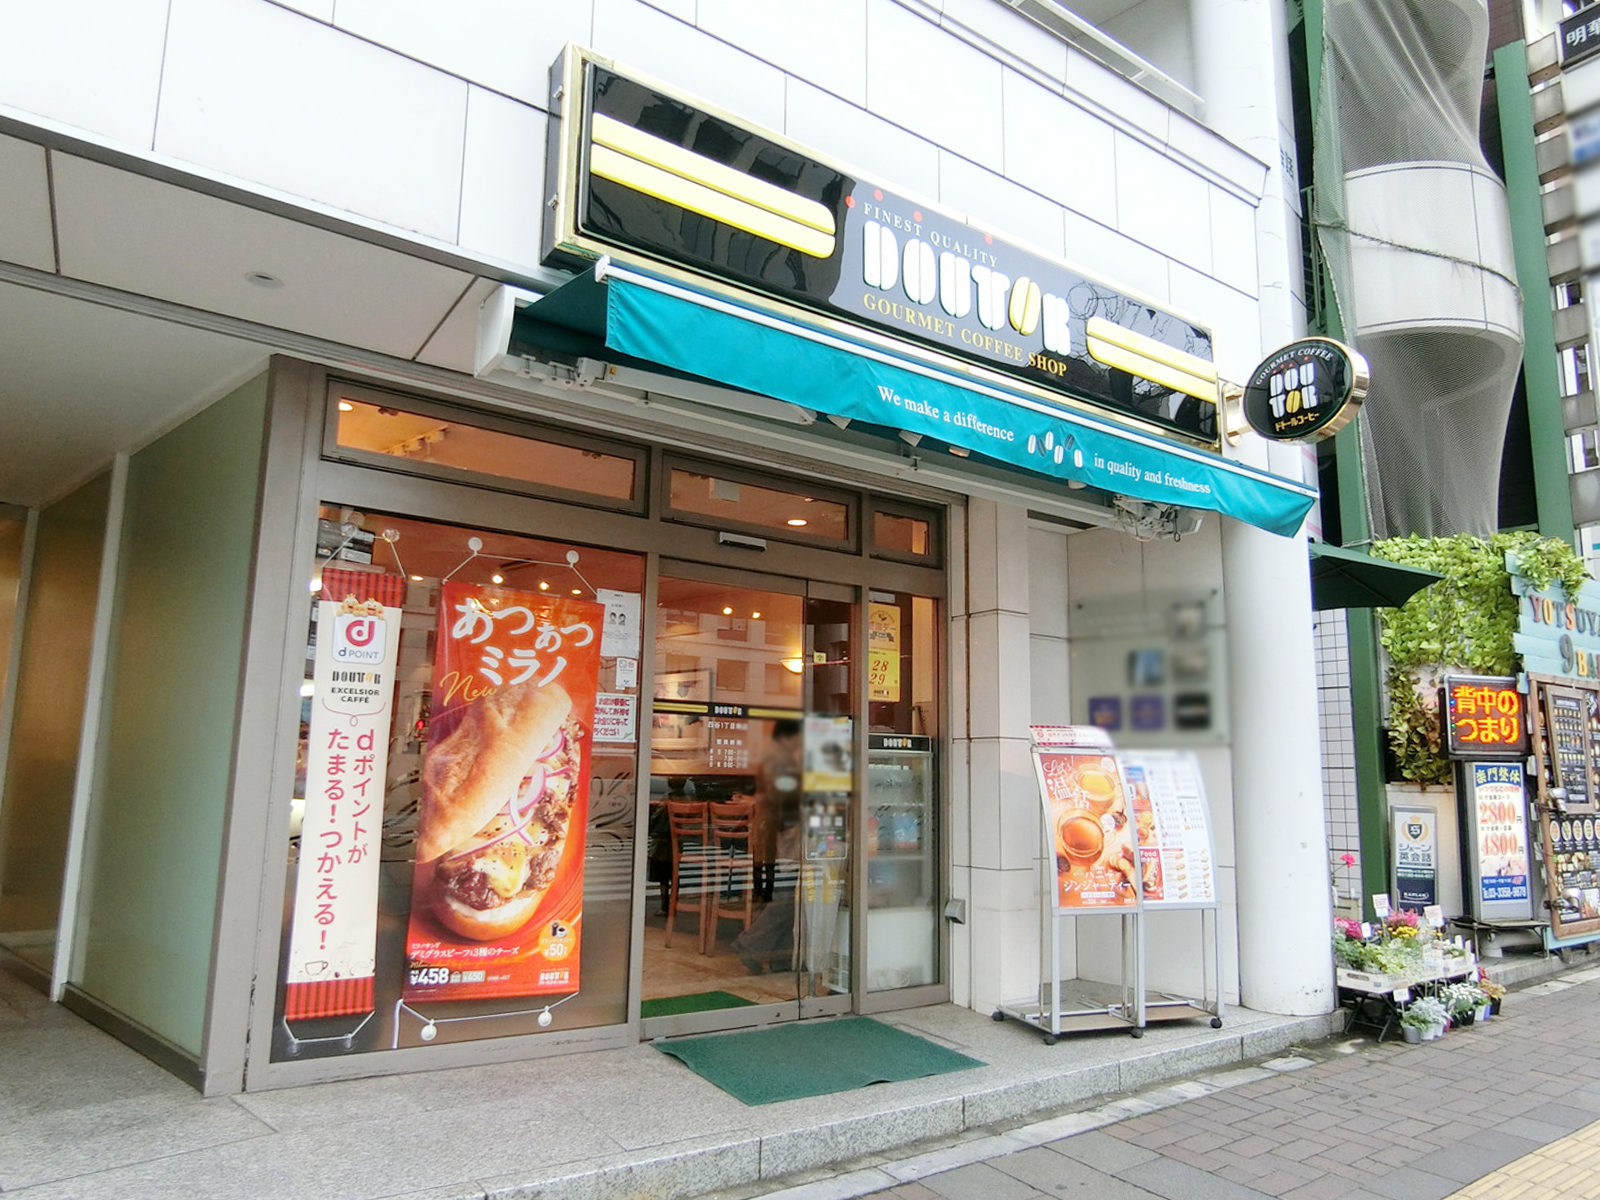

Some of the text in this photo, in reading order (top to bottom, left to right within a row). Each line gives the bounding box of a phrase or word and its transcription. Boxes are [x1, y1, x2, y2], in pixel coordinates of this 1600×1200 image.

[863, 201, 998, 268] FINEST QUALITY
[862, 219, 1071, 357] DOUTOR
[863, 292, 1068, 378] GOURMET COFFEE SHOP
[1256, 347, 1334, 386] GOURMET COFFEE
[877, 384, 1015, 443] We make a difference
[1275, 412, 1320, 432] ドトールコーヒー
[1093, 453, 1211, 495] in quality and freshness
[451, 597, 594, 653] あつあつ
[348, 650, 380, 660] POINT
[480, 645, 567, 688] ミラノ
[871, 660, 889, 672] 28
[331, 686, 380, 696] EXCELSIOR
[332, 670, 381, 684] DOUTOR
[439, 671, 498, 707] New
[868, 673, 886, 685] 29
[714, 705, 742, 716] DOUTOR
[1454, 685, 1520, 715] 背中の
[883, 737, 912, 748] DOUTOR
[1455, 717, 1520, 744] つまり
[347, 728, 375, 865] dポイントが
[1063, 880, 1132, 892] ジンジャーティー
